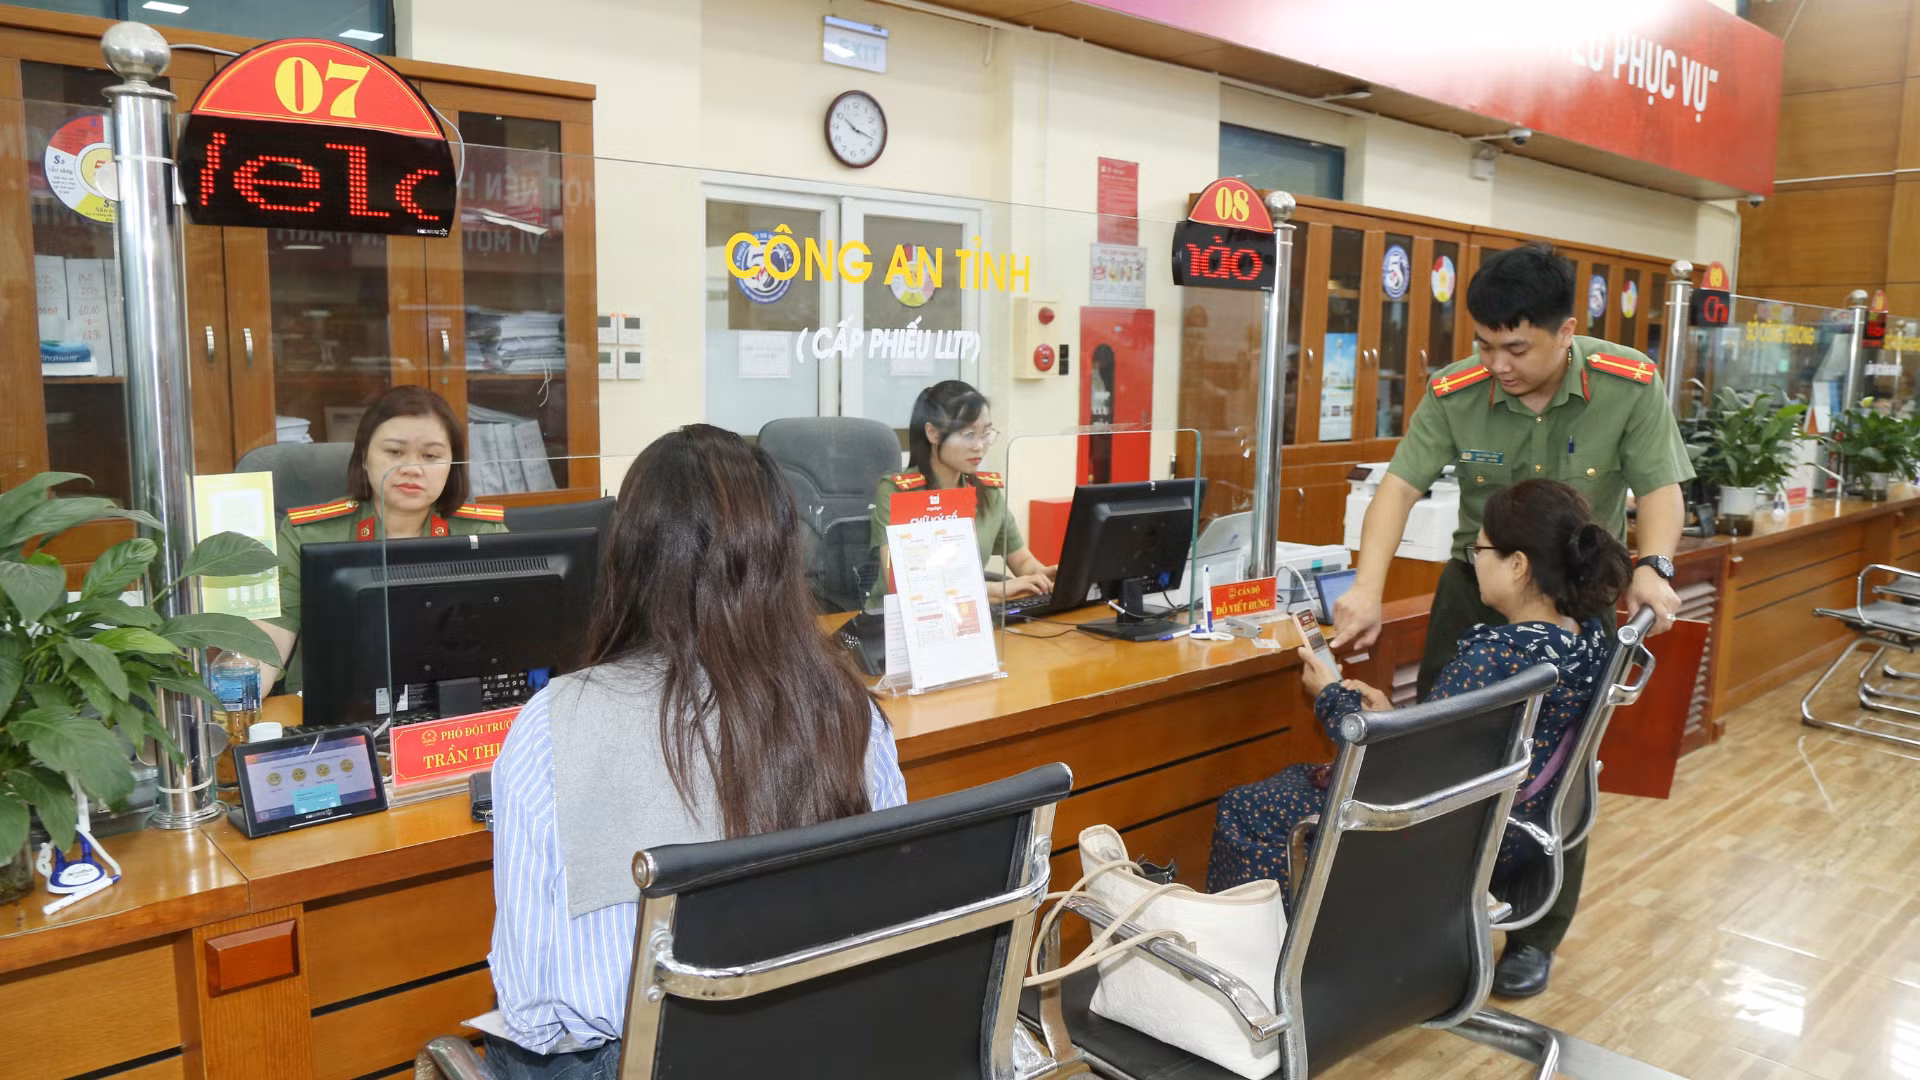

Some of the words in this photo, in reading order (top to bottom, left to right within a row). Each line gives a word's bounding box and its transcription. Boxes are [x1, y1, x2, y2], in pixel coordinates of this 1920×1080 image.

[838, 38, 881, 65] EXIT
[1612, 31, 1677, 105] PHỤC
[274, 56, 370, 118] 07
[1215, 186, 1250, 222] 08
[725, 223, 873, 284] CÔNG
[883, 244, 943, 288] AN
[955, 235, 1030, 293] TỈNH
[812, 314, 864, 360] CẤP
[868, 315, 931, 360] PHIẾU
[1228, 599, 1248, 613] VIẾT
[441, 726, 463, 741] PHÓ
[465, 723, 484, 737] ĐỘI
[423, 743, 469, 769] TRẦN
